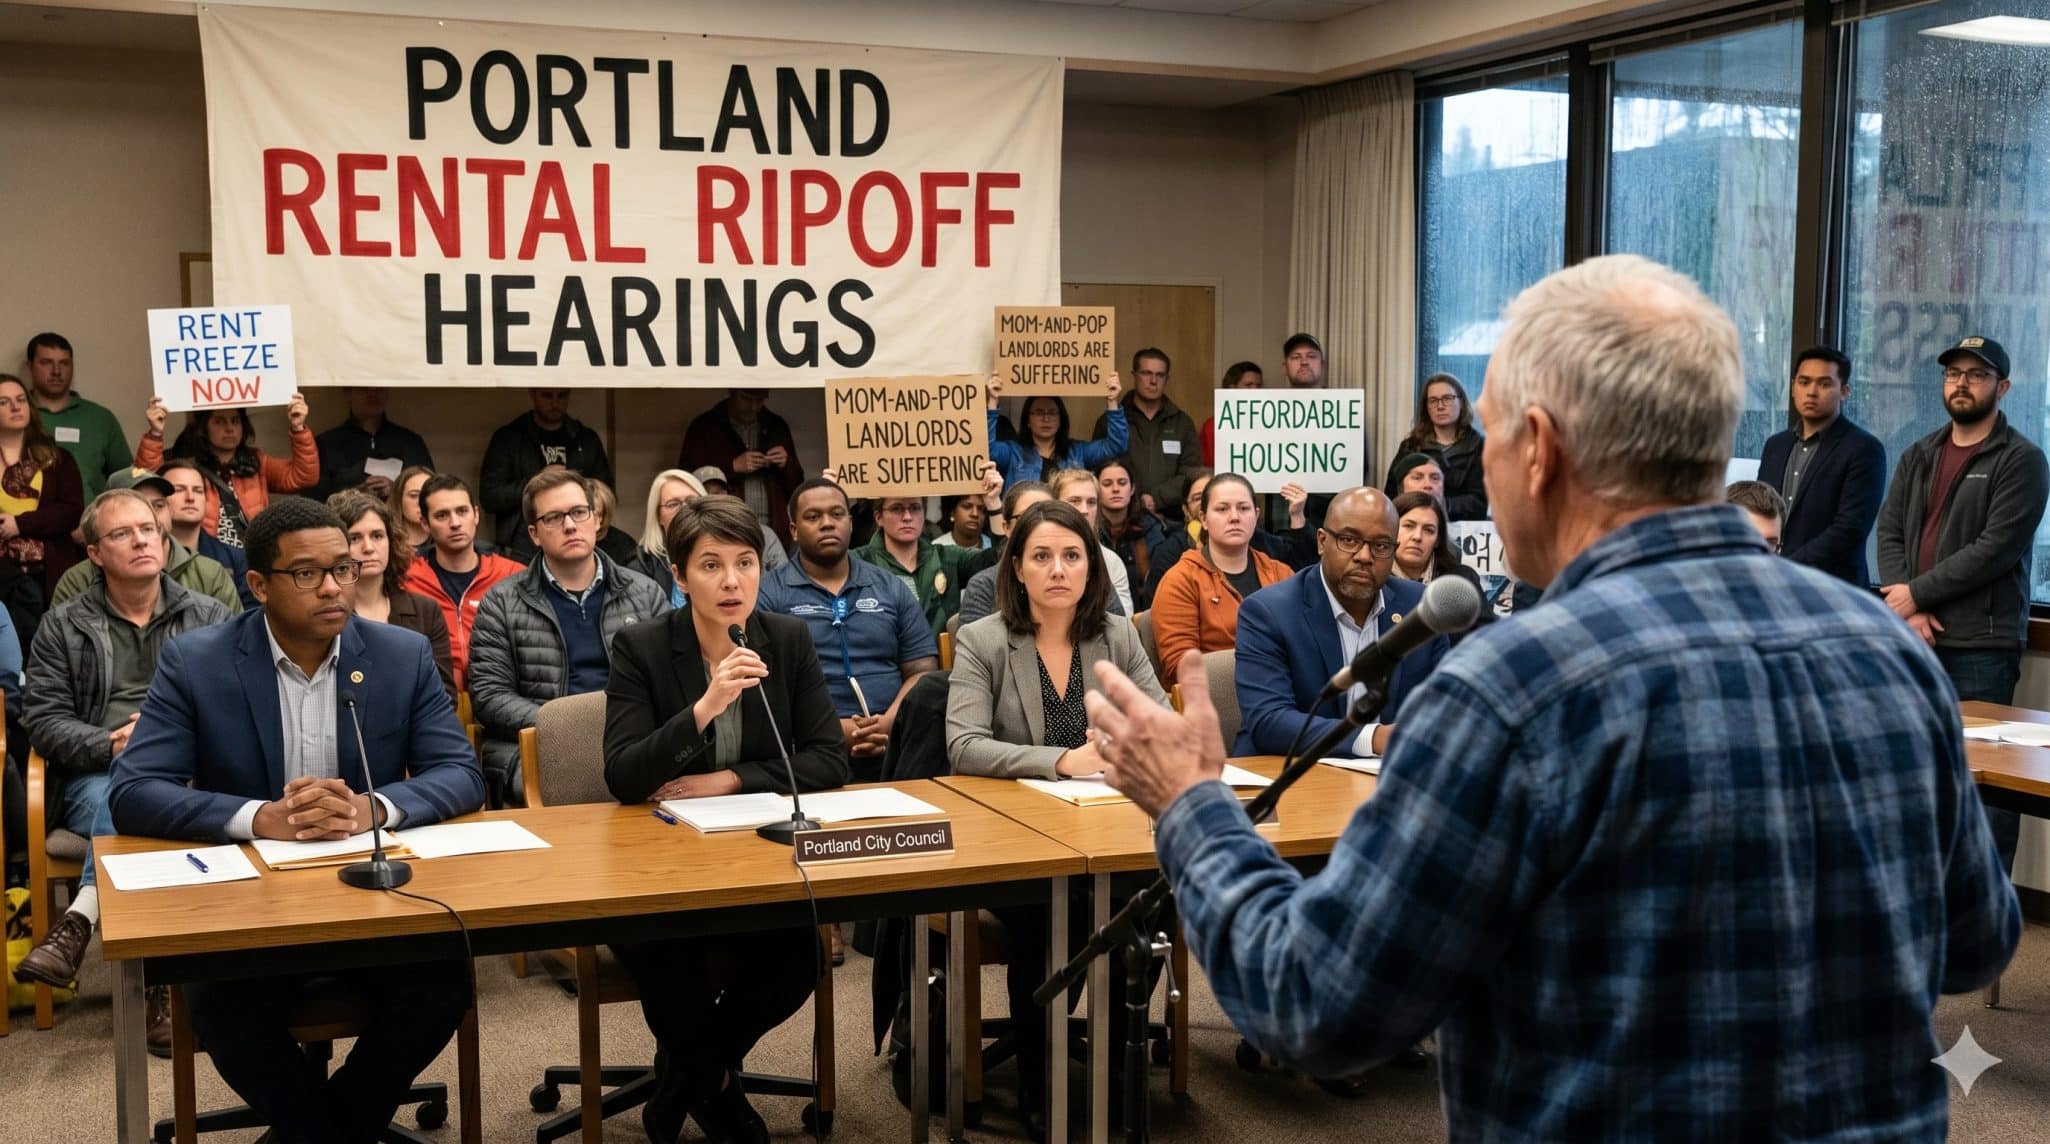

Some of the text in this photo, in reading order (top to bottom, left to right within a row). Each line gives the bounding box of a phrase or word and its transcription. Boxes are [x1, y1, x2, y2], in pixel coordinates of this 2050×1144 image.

[405, 47, 890, 157] PORTLAND
[263, 148, 1020, 268] RENTAL RIPOFF
[178, 310, 263, 340] RENT
[425, 274, 875, 368] HEARINGS
[1001, 314, 1107, 334] MOM-AND-POP
[164, 343, 279, 374] FREEZE
[999, 341, 1110, 358] LANDLORDS ARE
[191, 375, 261, 404] NOW
[1010, 364, 1100, 385] SUFFERING
[835, 384, 977, 414] MOM-AND-POP
[1218, 399, 1361, 430] AFFORDABLE
[846, 419, 972, 449] LANDLORDS
[836, 454, 986, 484] ARE SUFFERING
[1230, 442, 1347, 473] HOUSING
[804, 829, 946, 856] Portland City Council
